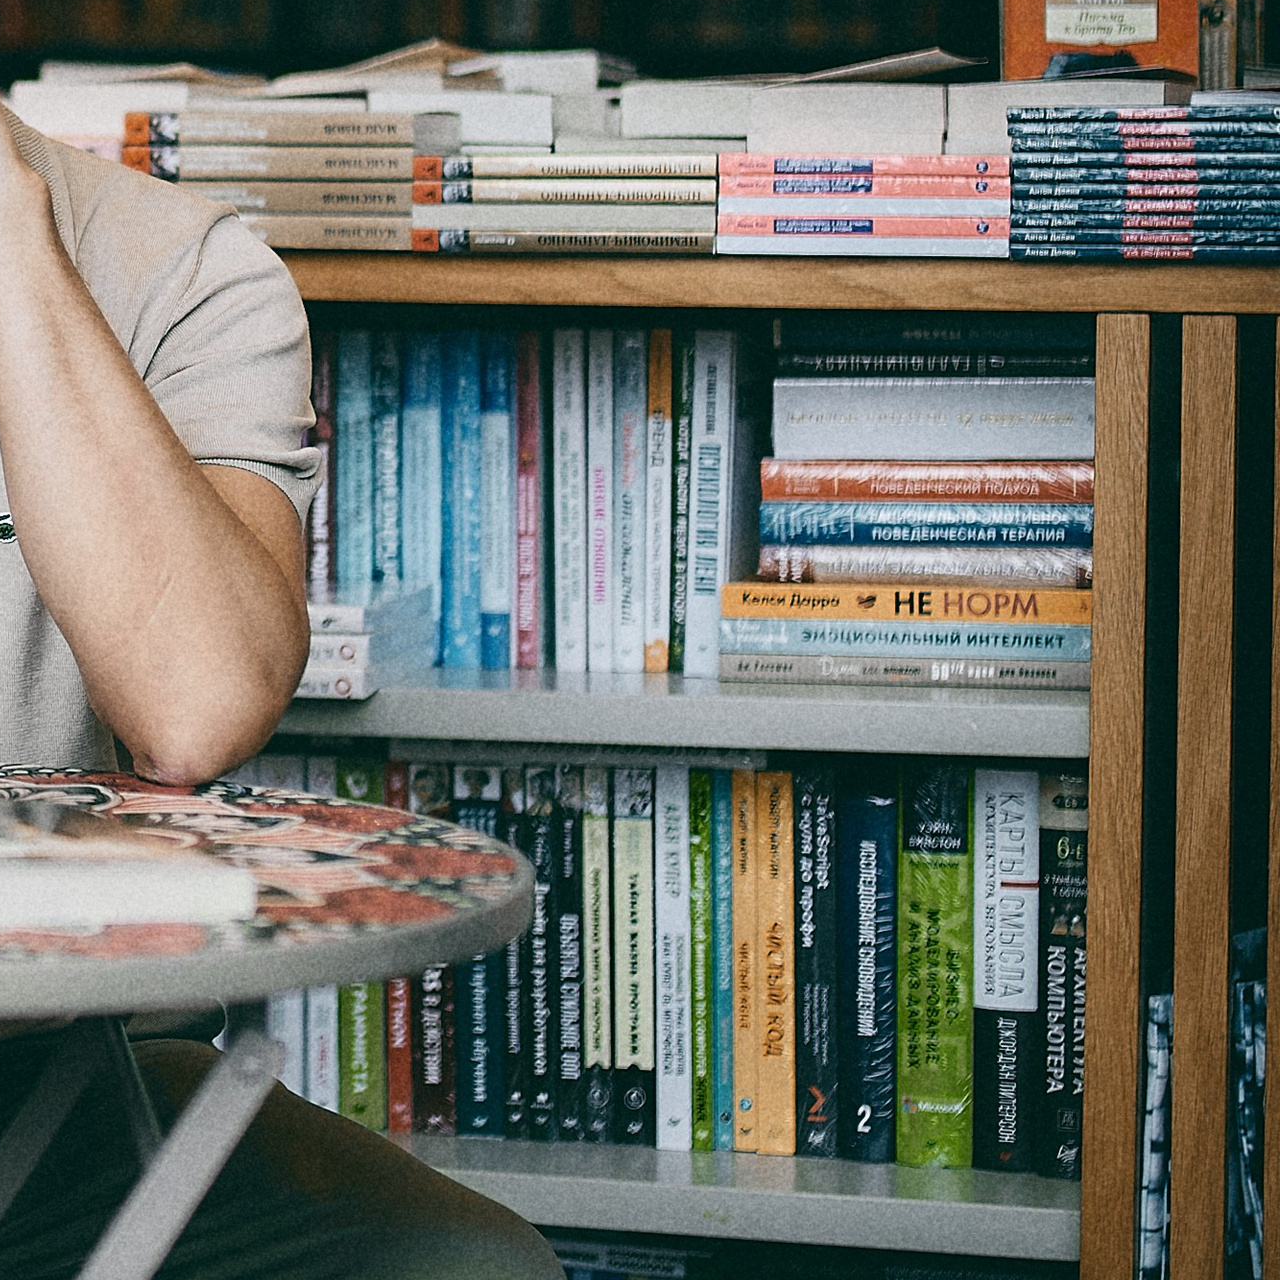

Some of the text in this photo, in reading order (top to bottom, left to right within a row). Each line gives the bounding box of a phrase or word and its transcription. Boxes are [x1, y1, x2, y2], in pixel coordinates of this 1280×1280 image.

[870, 482, 1040, 496] ПОВЕДЕНЧЕСКИЙ ПОДХОД
[872, 526, 1066, 542] ПОВЕДЕНЧЕСКАЯ ТЕРАПИЯ
[742, 592, 786, 607] Келси
[893, 591, 933, 616] НЕ
[943, 592, 1039, 618] НОРМ
[800, 629, 962, 647] ЭМОЦИОНАЛЬНЫЙ
[967, 632, 1066, 649] ИНТЕЛЛЕКТ
[800, 809, 814, 854] нуля
[814, 794, 833, 889] JavaScript
[984, 791, 997, 900] АРХИТЕКТУРА
[800, 856, 814, 882] до
[999, 791, 1026, 999] КАРТЫ СМЫСЛА
[799, 886, 817, 948] профи
[856, 840, 879, 1036] ИССЛЕДОВАНИЕ СНОВИДЕНИЙ
[766, 921, 788, 1006] ЧИСТЫЙ
[908, 921, 921, 991] АНАЛИЗ
[925, 909, 941, 1066] МОДЕЛИРОВАНИЕ
[560, 982, 580, 1051] СТИЛЬНОЕ
[762, 1012, 784, 1058] КОД
[905, 993, 920, 1071] ДАННЫХ
[1046, 944, 1067, 1094] КОМПЬЮТЕРА
[1072, 946, 1087, 1095] АРХИТЕКТУРА
[470, 1037, 490, 1102] обучения
[997, 1017, 1018, 1144] ДЖОРДАН ПИТЕРСОН
[857, 1104, 872, 1133] 2
